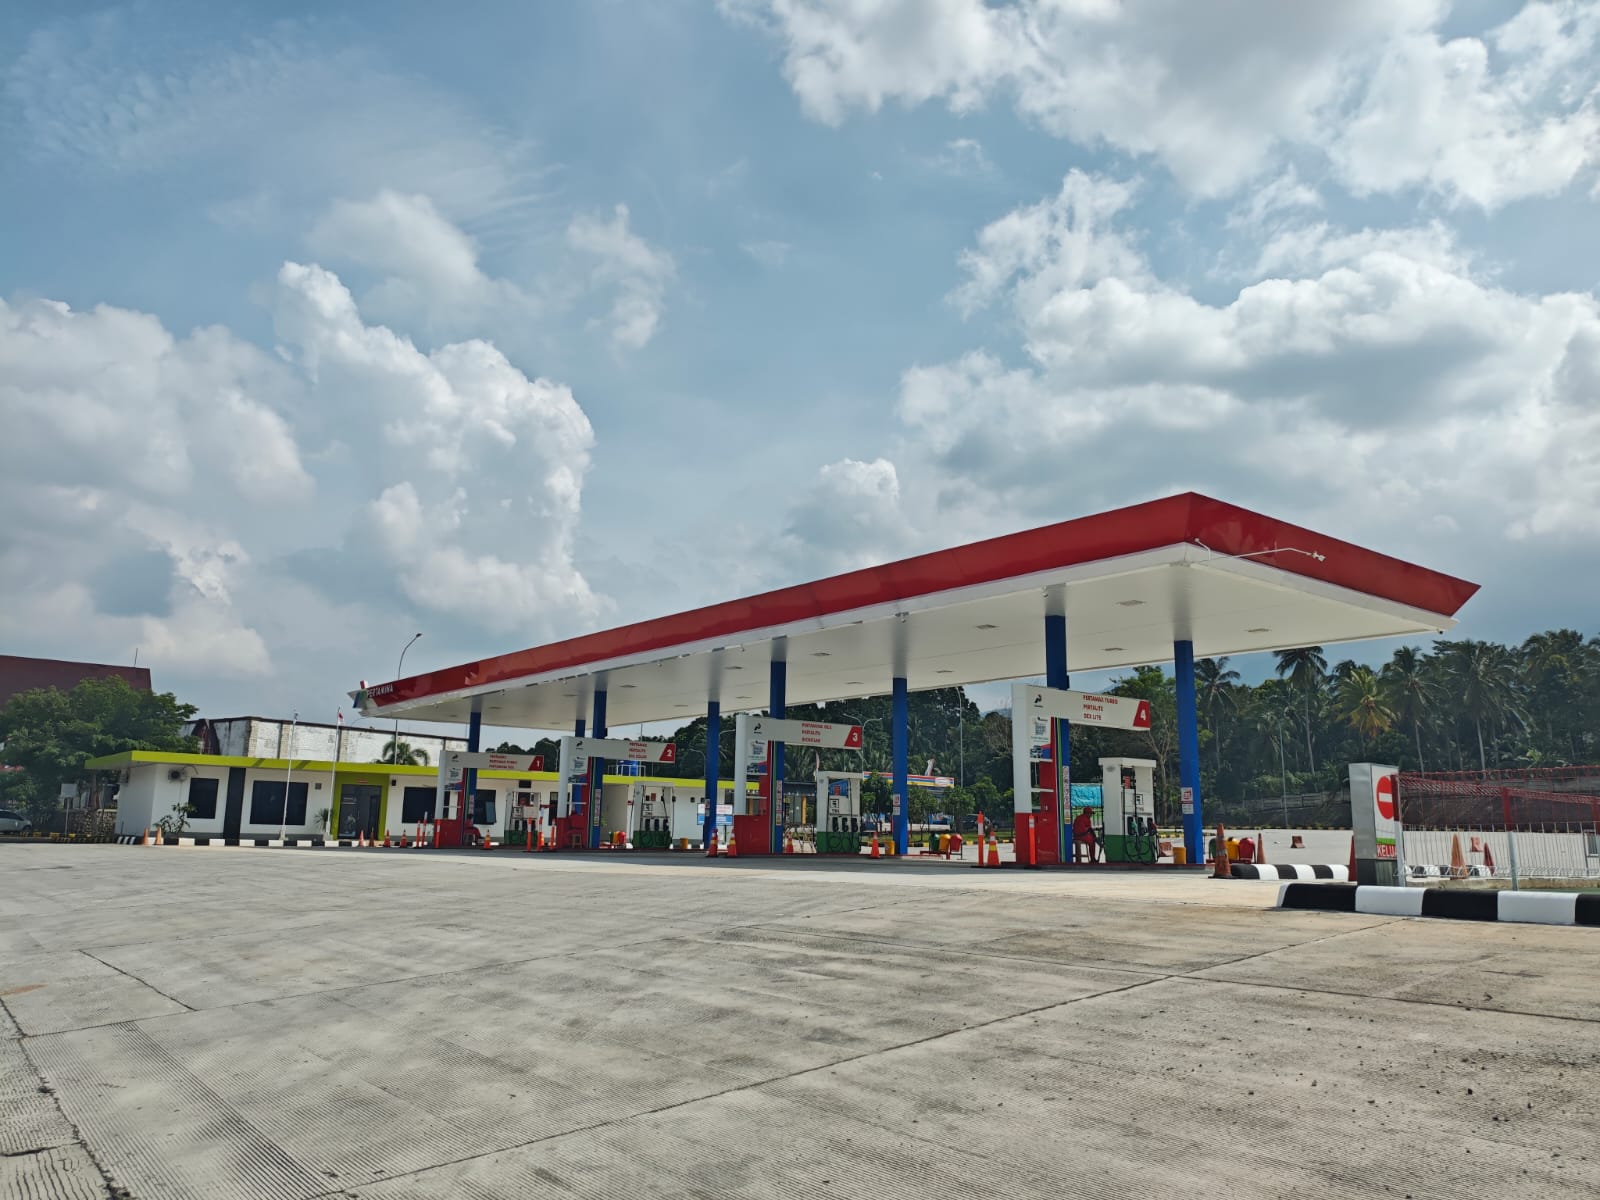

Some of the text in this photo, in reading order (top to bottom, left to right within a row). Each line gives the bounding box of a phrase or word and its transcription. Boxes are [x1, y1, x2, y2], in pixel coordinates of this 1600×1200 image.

[367, 683, 394, 698] PERTAMINA
[1140, 709, 1147, 721] 4
[852, 732, 859, 743] 3
[667, 749, 673, 757] 2
